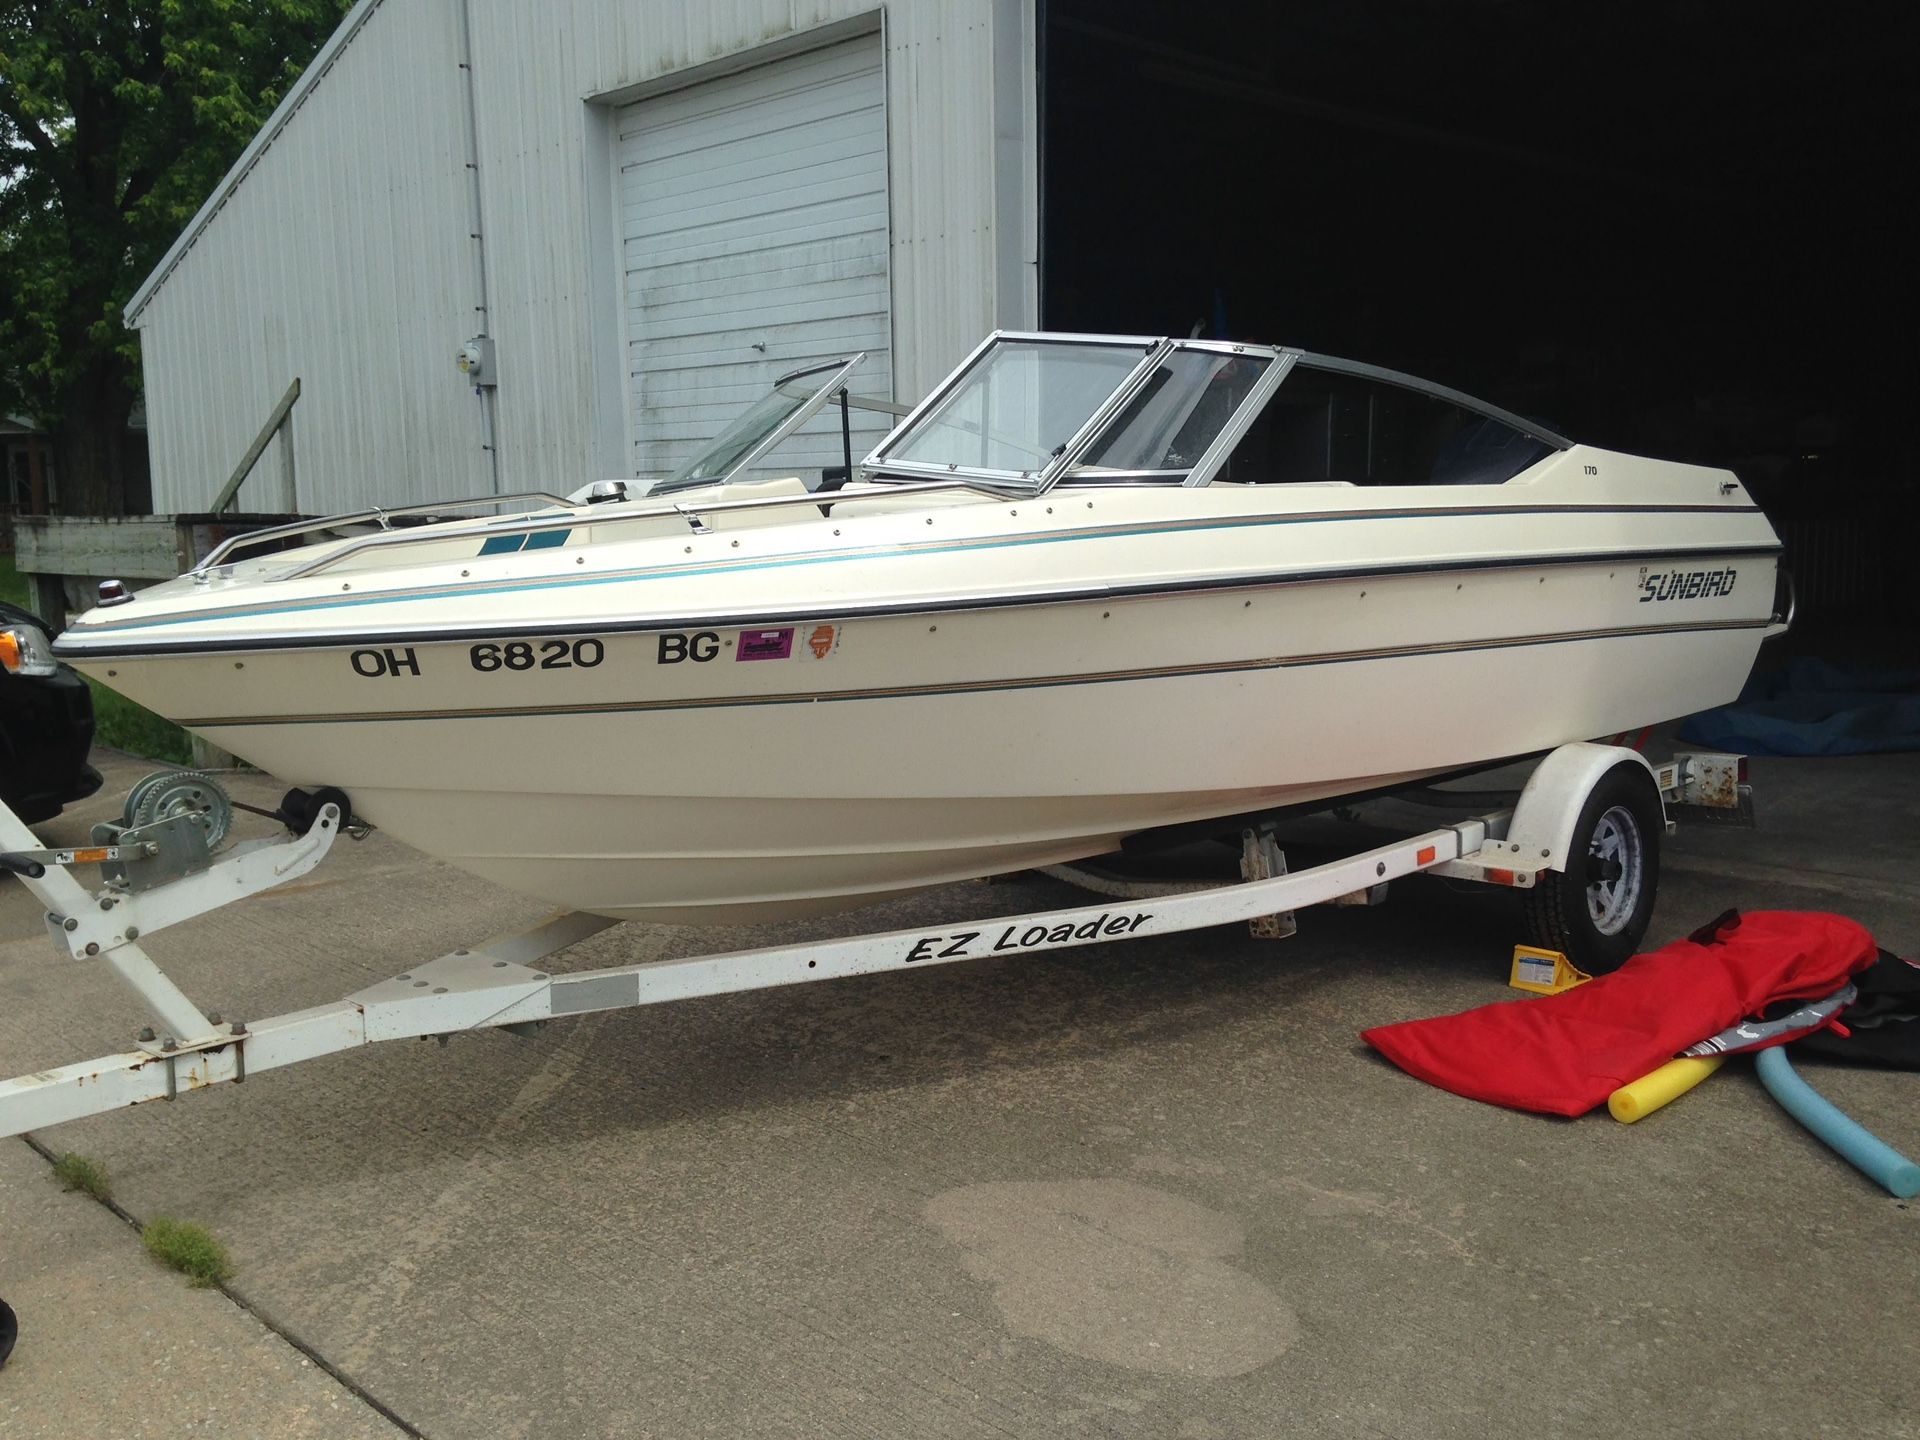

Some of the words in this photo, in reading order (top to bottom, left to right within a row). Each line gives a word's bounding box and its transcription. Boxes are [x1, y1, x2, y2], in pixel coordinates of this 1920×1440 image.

[1584, 465, 1598, 476] 170
[1639, 569, 1737, 603] SUNBIRD
[350, 647, 421, 677] OH
[469, 638, 605, 672] 6820
[657, 631, 720, 665] BG
[905, 932, 980, 963] EZ
[993, 913, 1153, 952] Loader
